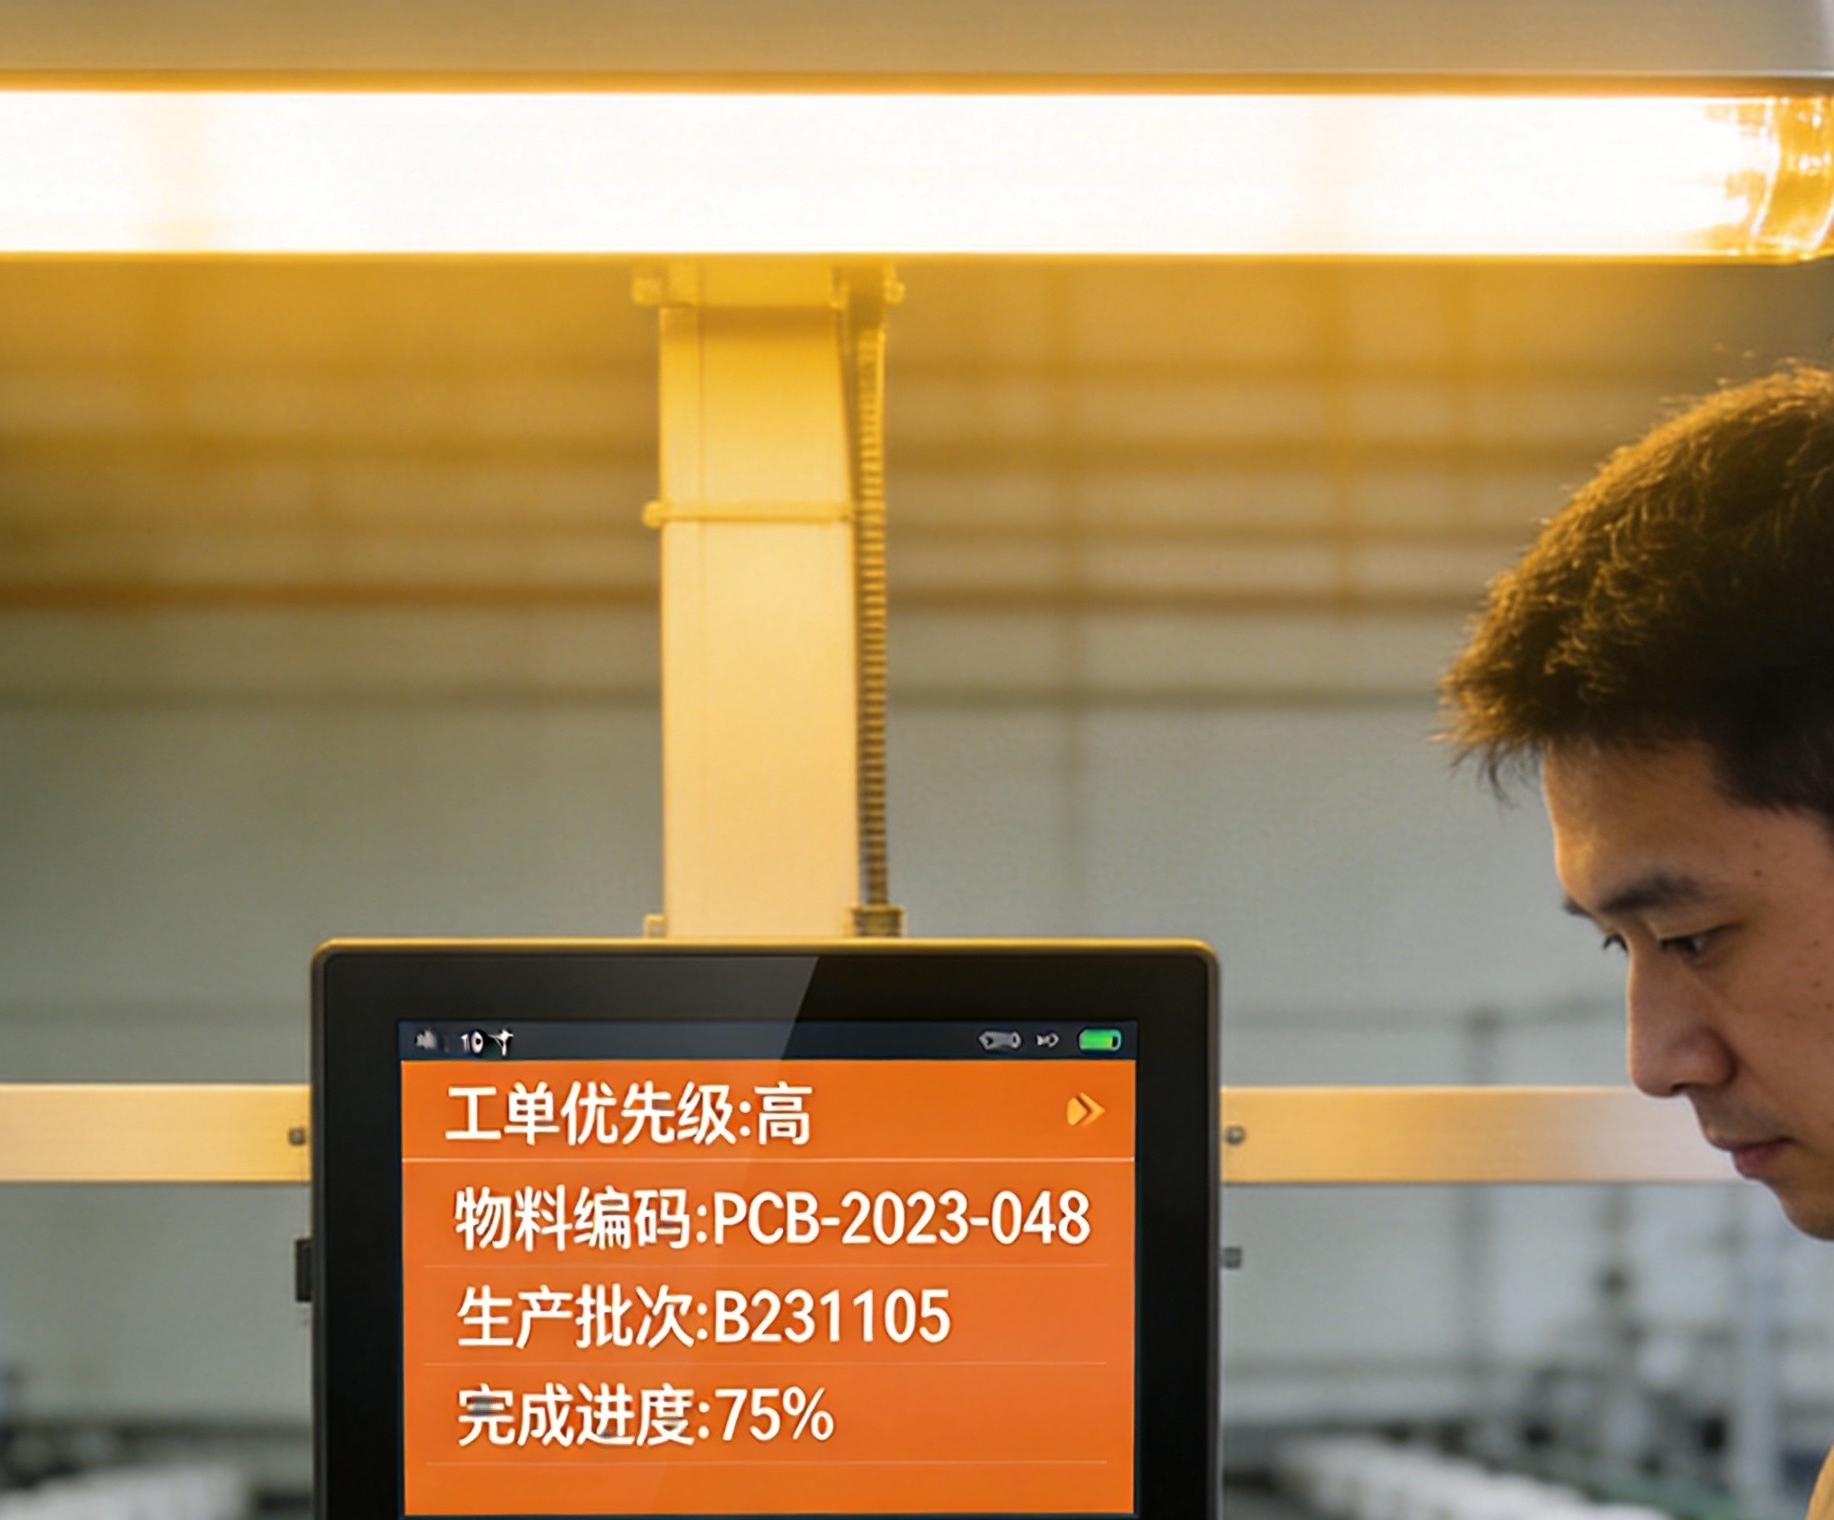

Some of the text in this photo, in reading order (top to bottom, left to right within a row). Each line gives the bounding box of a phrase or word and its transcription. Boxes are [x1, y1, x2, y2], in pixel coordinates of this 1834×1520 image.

[445, 1080, 813, 1146] 工单优先级:高
[454, 1184, 1091, 1252] 物料编码:PCB-2023-048
[457, 1283, 951, 1350] 生产批次:B231105
[457, 1381, 835, 1448] 完成进度:75%
